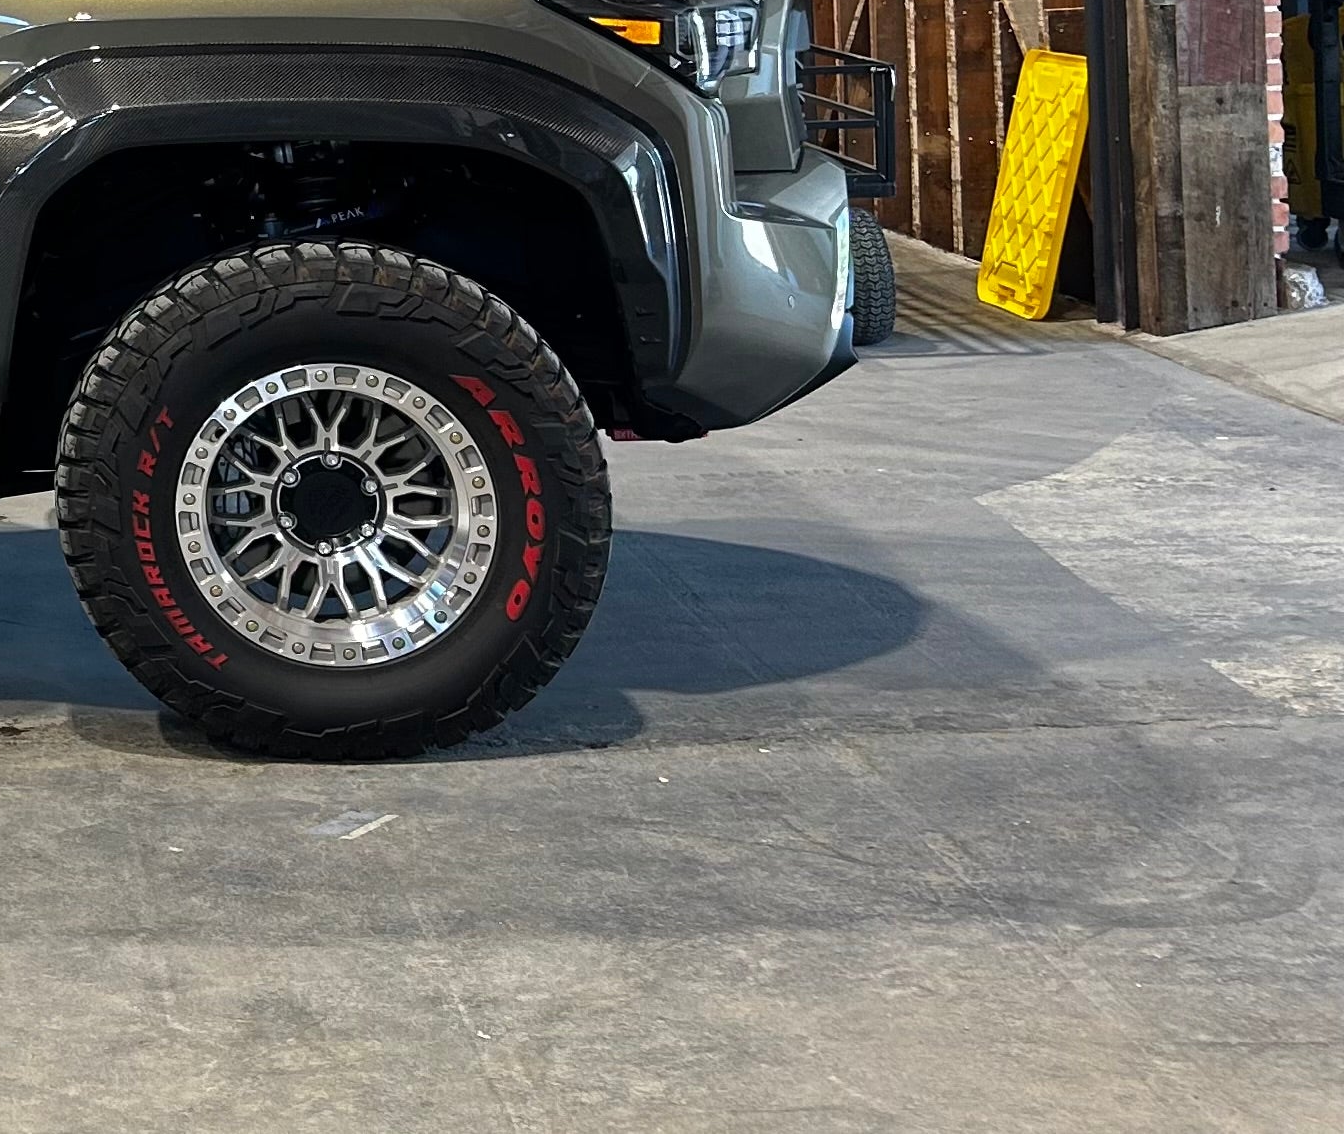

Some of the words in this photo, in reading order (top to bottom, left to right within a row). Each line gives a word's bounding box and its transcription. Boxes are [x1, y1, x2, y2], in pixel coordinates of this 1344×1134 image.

[331, 206, 365, 224] PEAK
[137, 405, 174, 477] R/T
[448, 373, 547, 622] ARROYO
[132, 489, 229, 671] TAMAROCK
